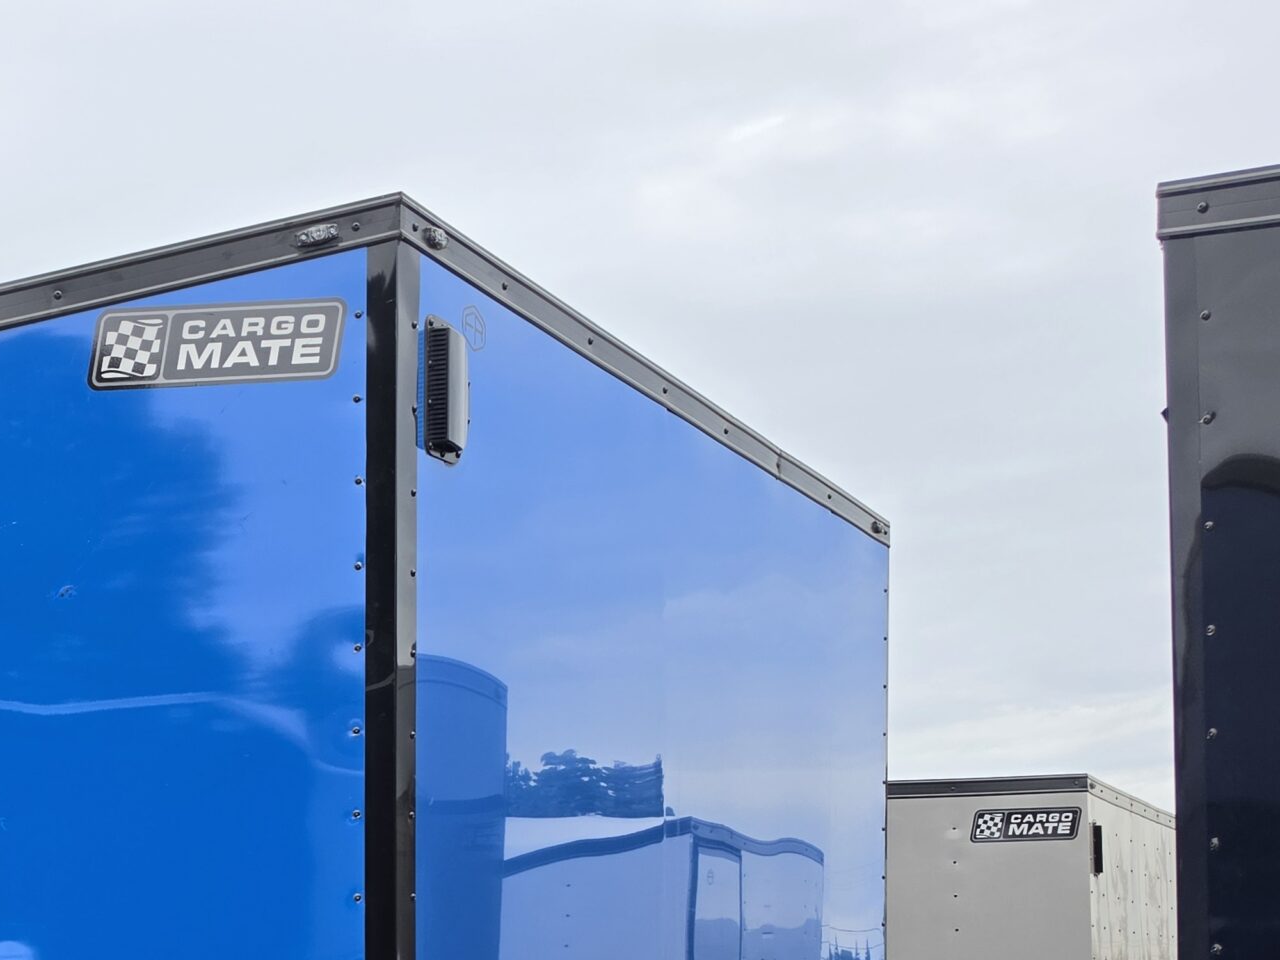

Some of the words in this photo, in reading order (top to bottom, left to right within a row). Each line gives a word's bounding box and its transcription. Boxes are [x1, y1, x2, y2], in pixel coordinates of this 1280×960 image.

[182, 314, 326, 340] CARGO
[176, 337, 323, 370] MATE
[1010, 812, 1073, 823] CARGO
[1008, 822, 1072, 835] MATE
